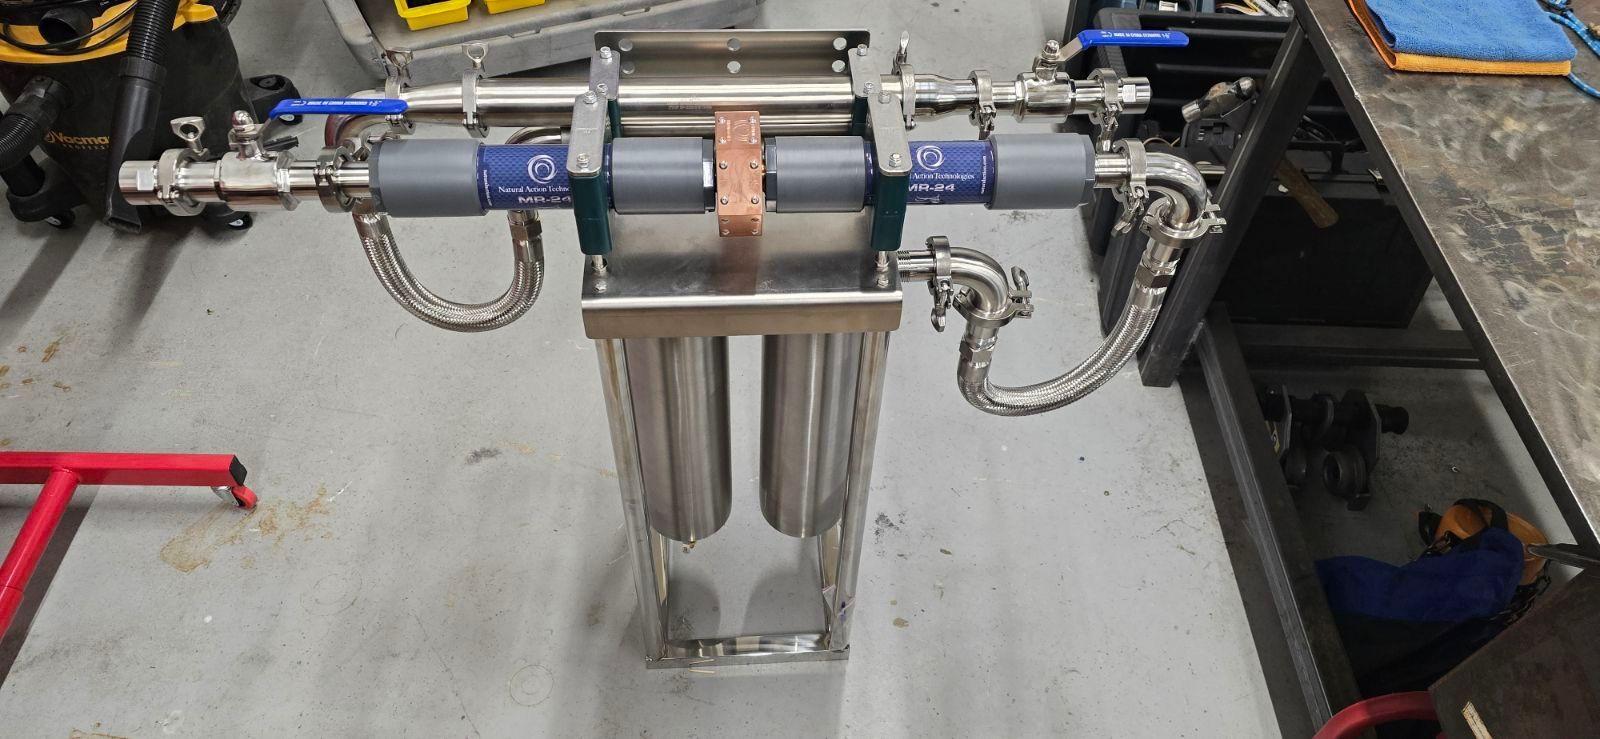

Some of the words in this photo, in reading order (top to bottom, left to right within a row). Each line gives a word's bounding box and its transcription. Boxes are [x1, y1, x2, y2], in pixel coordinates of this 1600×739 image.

[51, 130, 109, 145] Vacma
[912, 172, 934, 180] Action
[933, 172, 975, 182] Technologies
[498, 185, 524, 193] Natural
[525, 185, 548, 193] Action
[517, 195, 571, 204] MR-24
